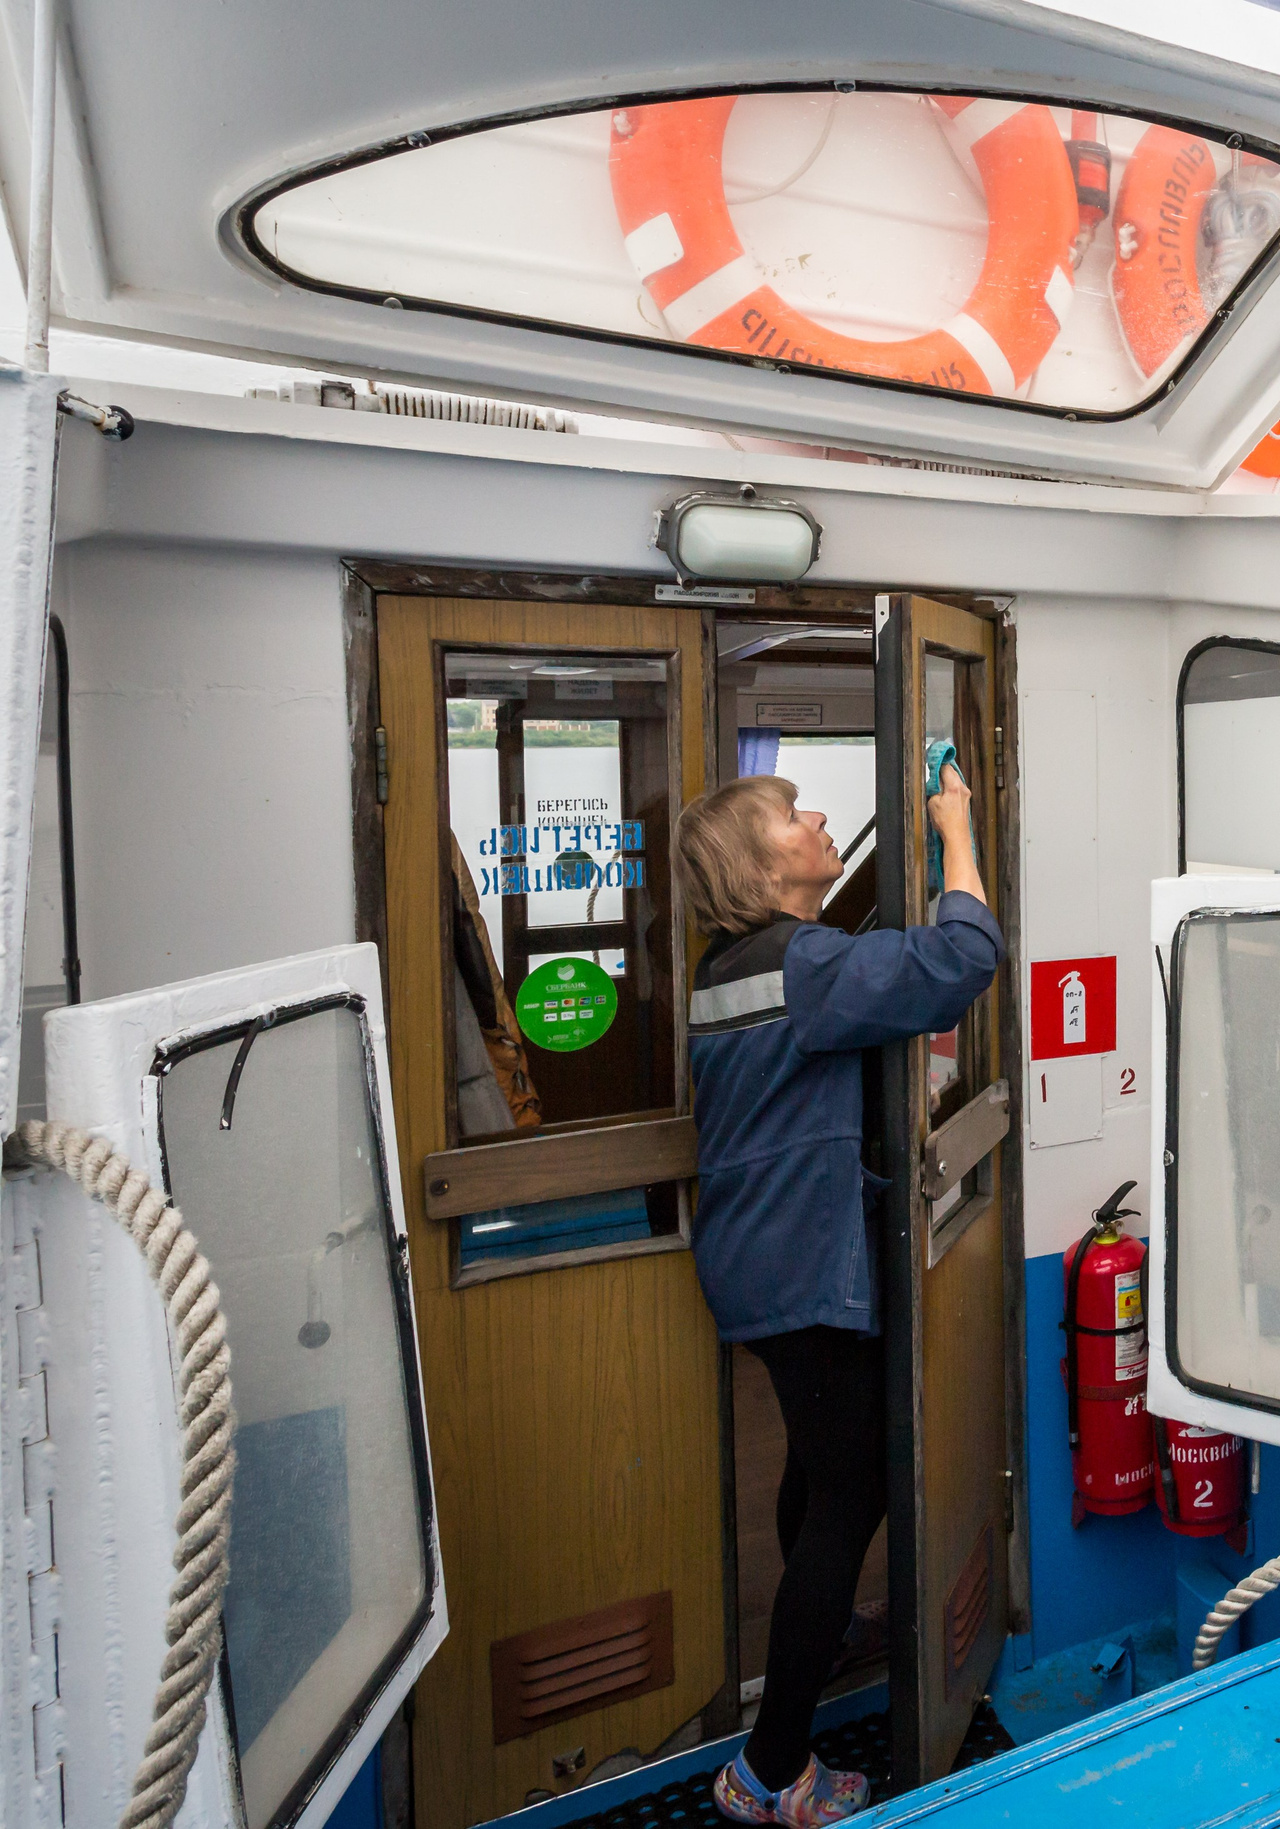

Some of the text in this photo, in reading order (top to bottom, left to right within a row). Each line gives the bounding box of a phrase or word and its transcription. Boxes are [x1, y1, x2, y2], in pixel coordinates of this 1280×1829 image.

[537, 798, 608, 812] БЕРЕГИСЬ
[545, 982, 587, 992] СБЕРБАНК
[1040, 1072, 1047, 1103] 1
[1119, 1067, 1137, 1096] 2
[1193, 1480, 1214, 1508] 2
